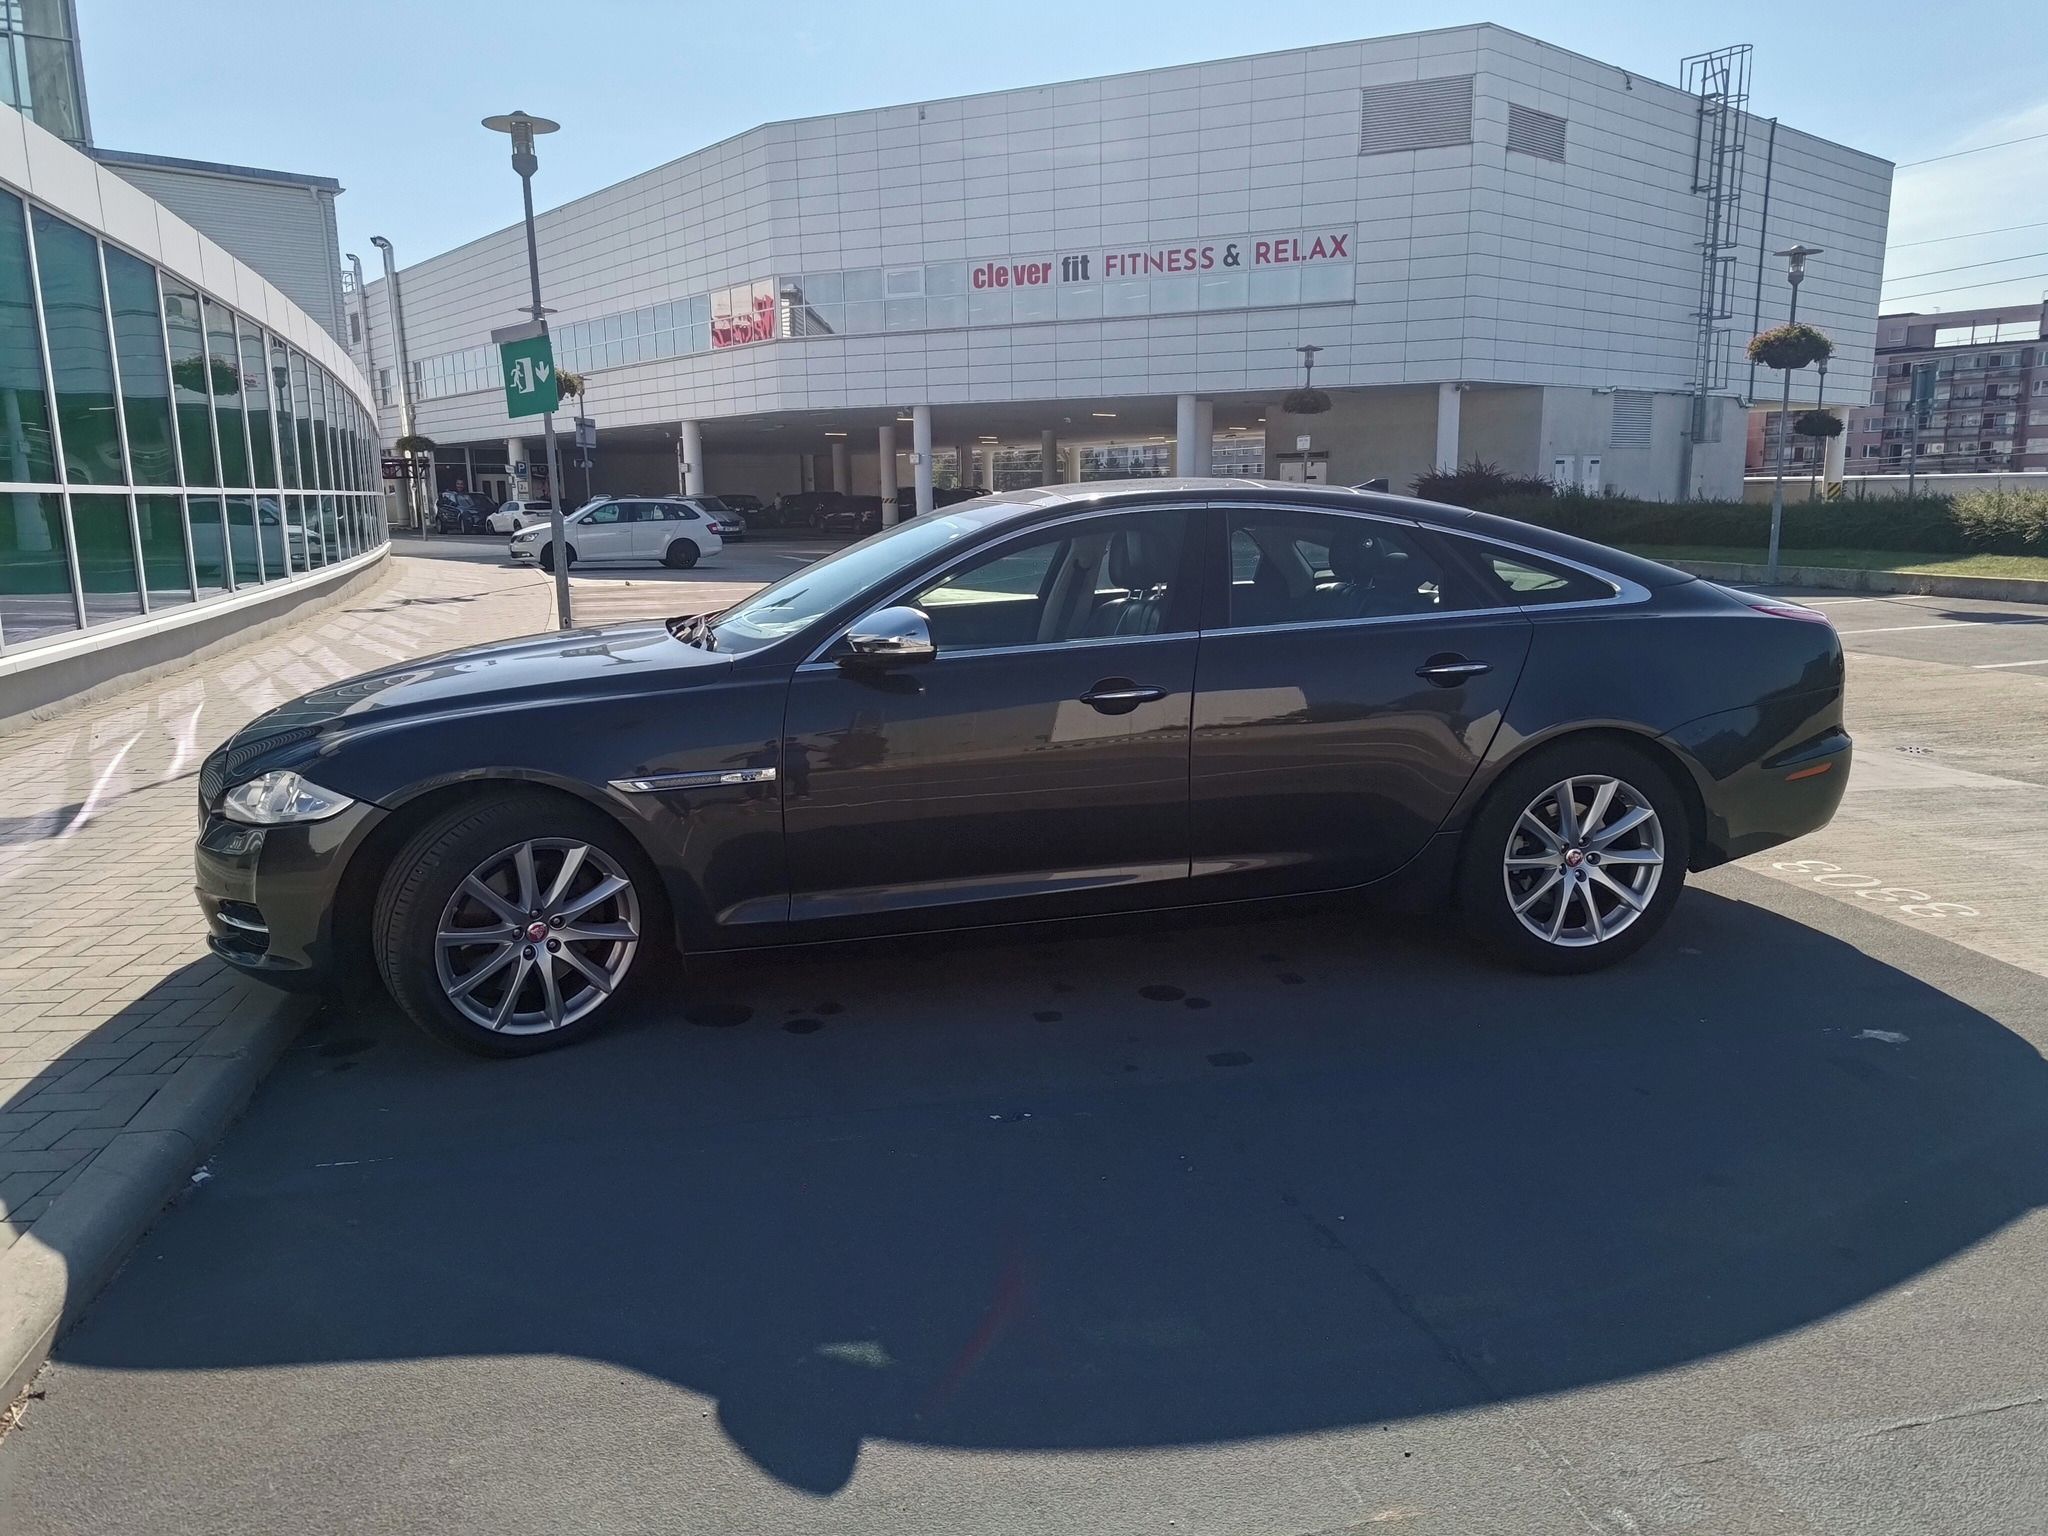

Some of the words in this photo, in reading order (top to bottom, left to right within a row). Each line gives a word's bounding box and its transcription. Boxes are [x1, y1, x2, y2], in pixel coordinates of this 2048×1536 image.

[973, 262, 1052, 289] clever
[1061, 254, 1090, 282] fit
[1105, 246, 1215, 277] FITNESS
[1223, 243, 1241, 267] &
[1255, 234, 1348, 265] RELAX
[518, 463, 525, 473] P
[1771, 860, 1981, 918] 3303
